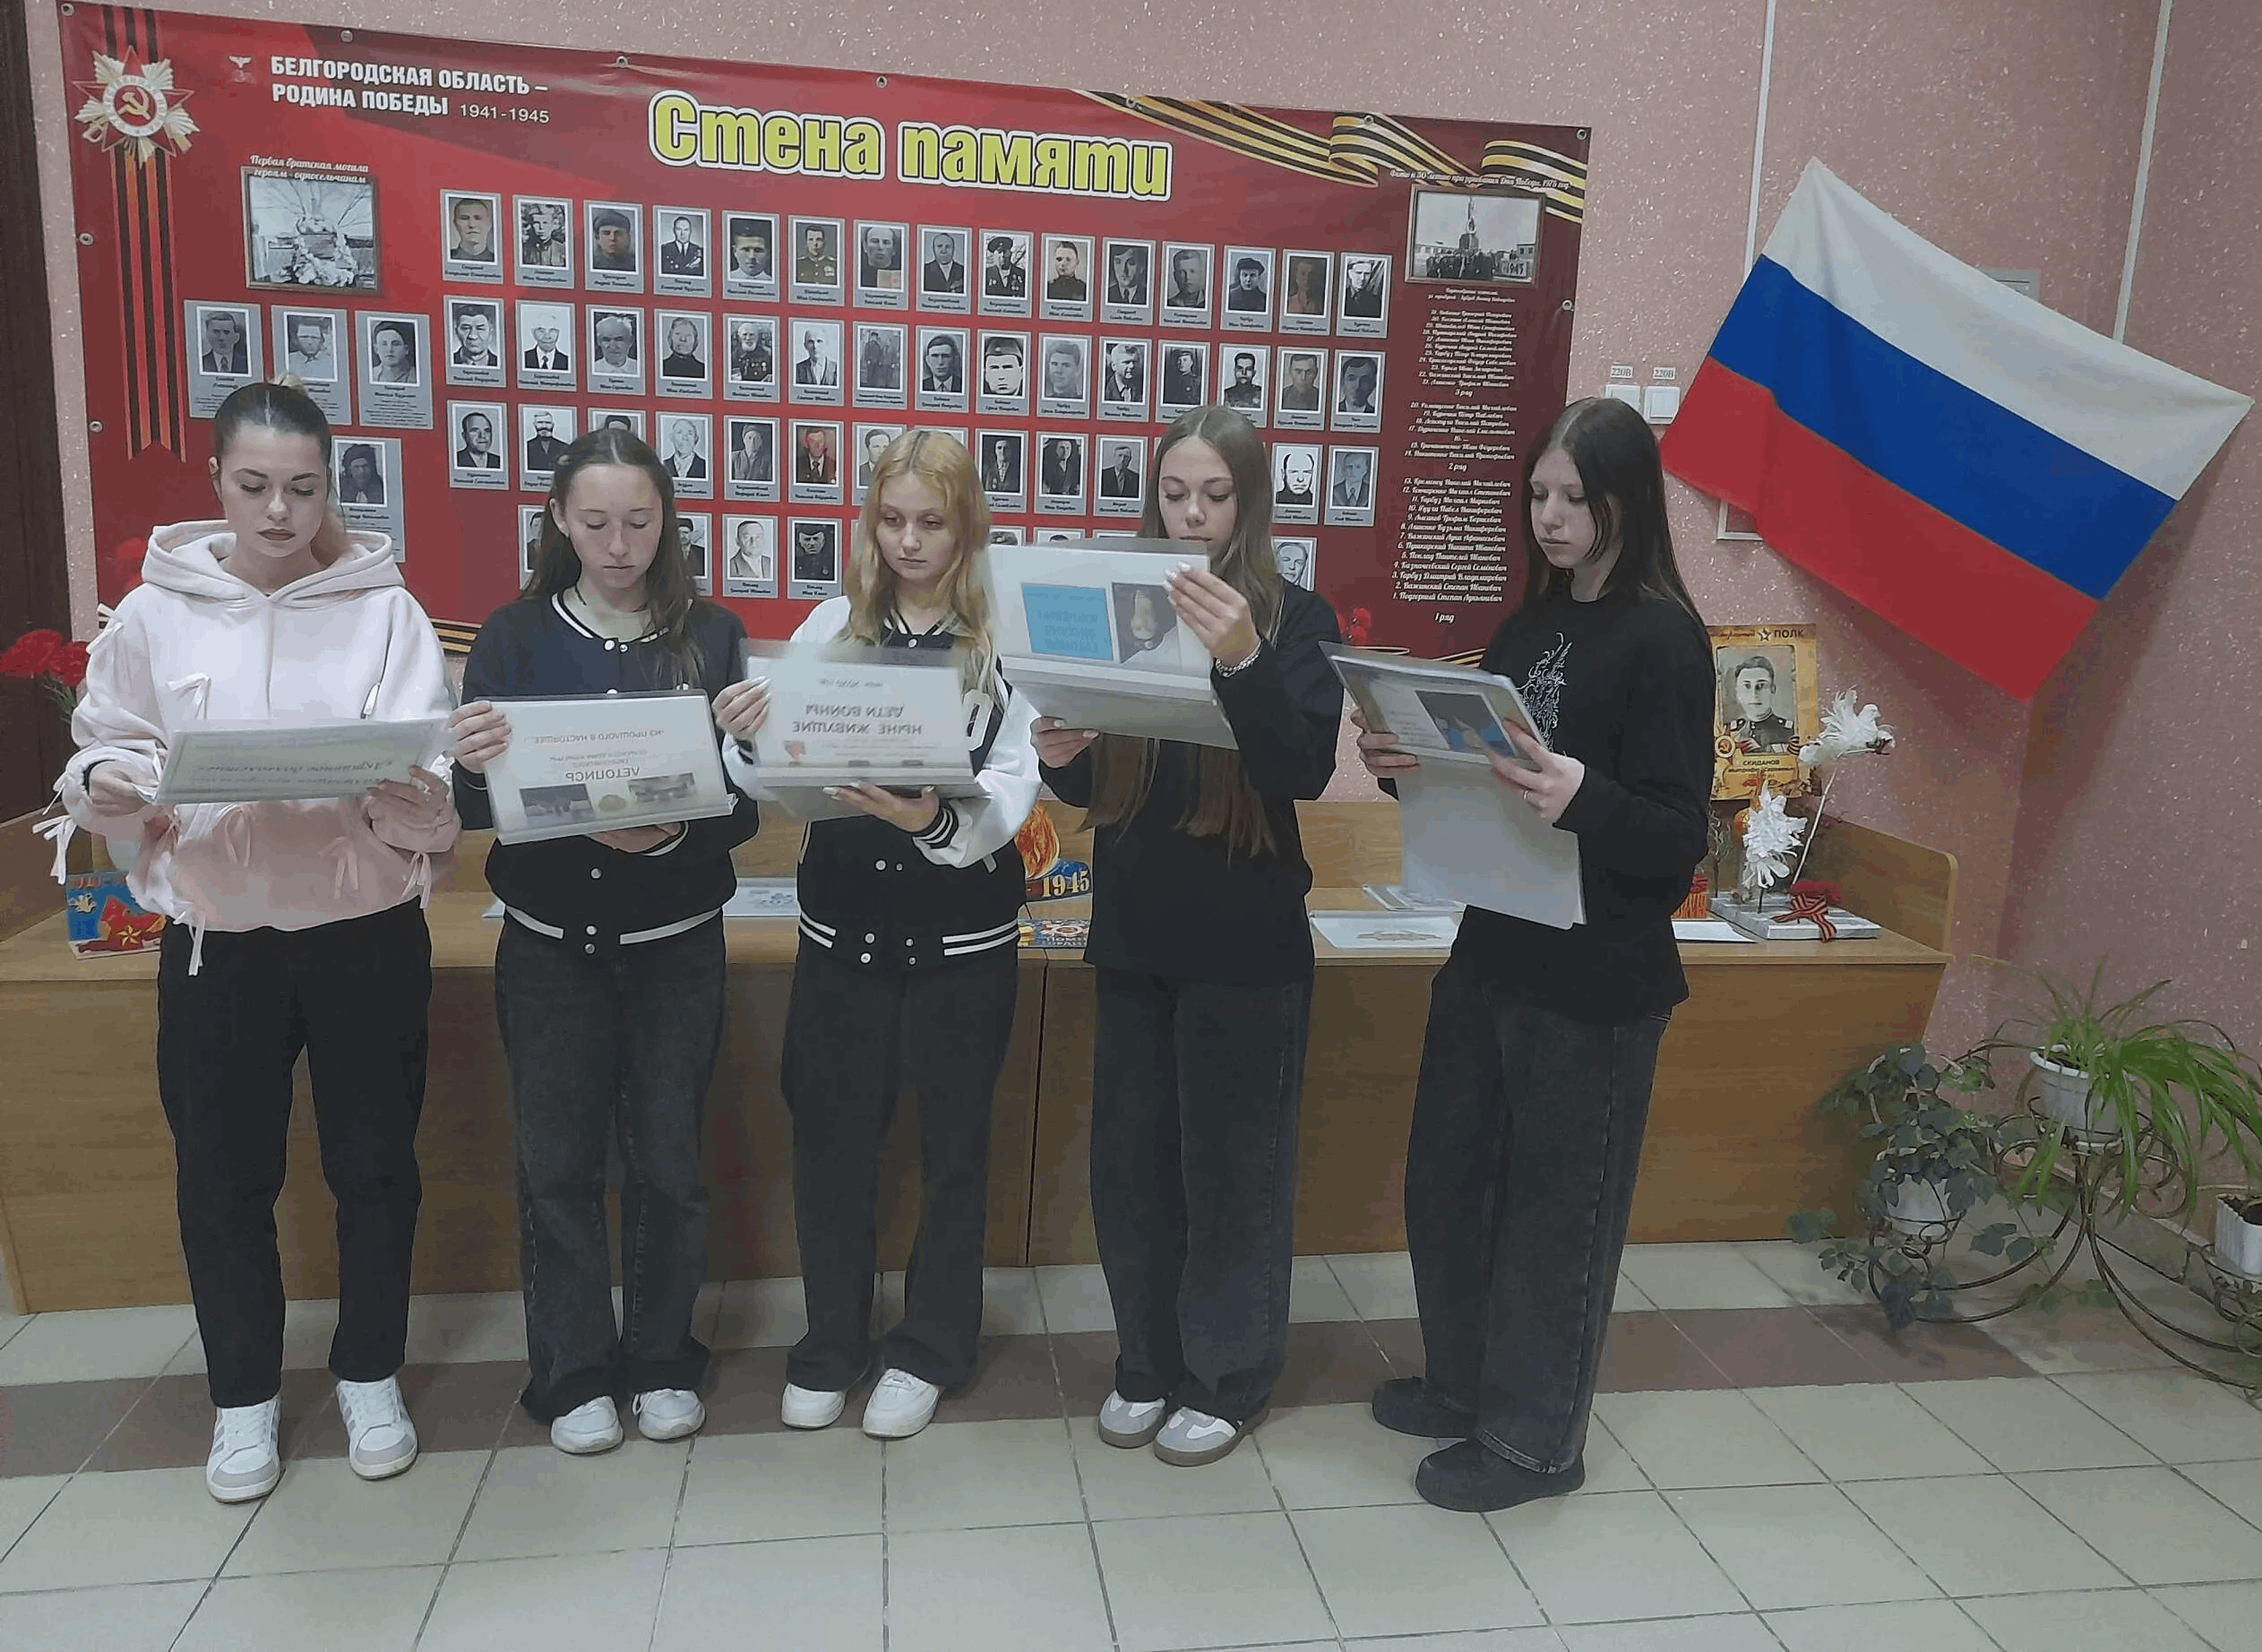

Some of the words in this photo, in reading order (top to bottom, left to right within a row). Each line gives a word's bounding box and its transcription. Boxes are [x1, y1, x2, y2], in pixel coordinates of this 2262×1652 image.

[271, 55, 433, 87] БЕЛГОРОДСКАЯ
[438, 67, 529, 95] ОБЛАСТЬ
[272, 82, 356, 109] РОДИНА
[361, 90, 450, 117] ПОБЕДЫ
[459, 102, 550, 125] 1941-1945
[650, 90, 883, 179] Стена
[899, 123, 1172, 201] памяти
[250, 155, 285, 167] Первая
[1439, 614, 1455, 623] ряд
[1774, 629, 1804, 639] ПОЛК
[805, 703, 861, 717] ВОЙНЫ
[565, 767, 640, 782] ЛЕТОПИСЬ
[1042, 871, 1089, 898] 1945
